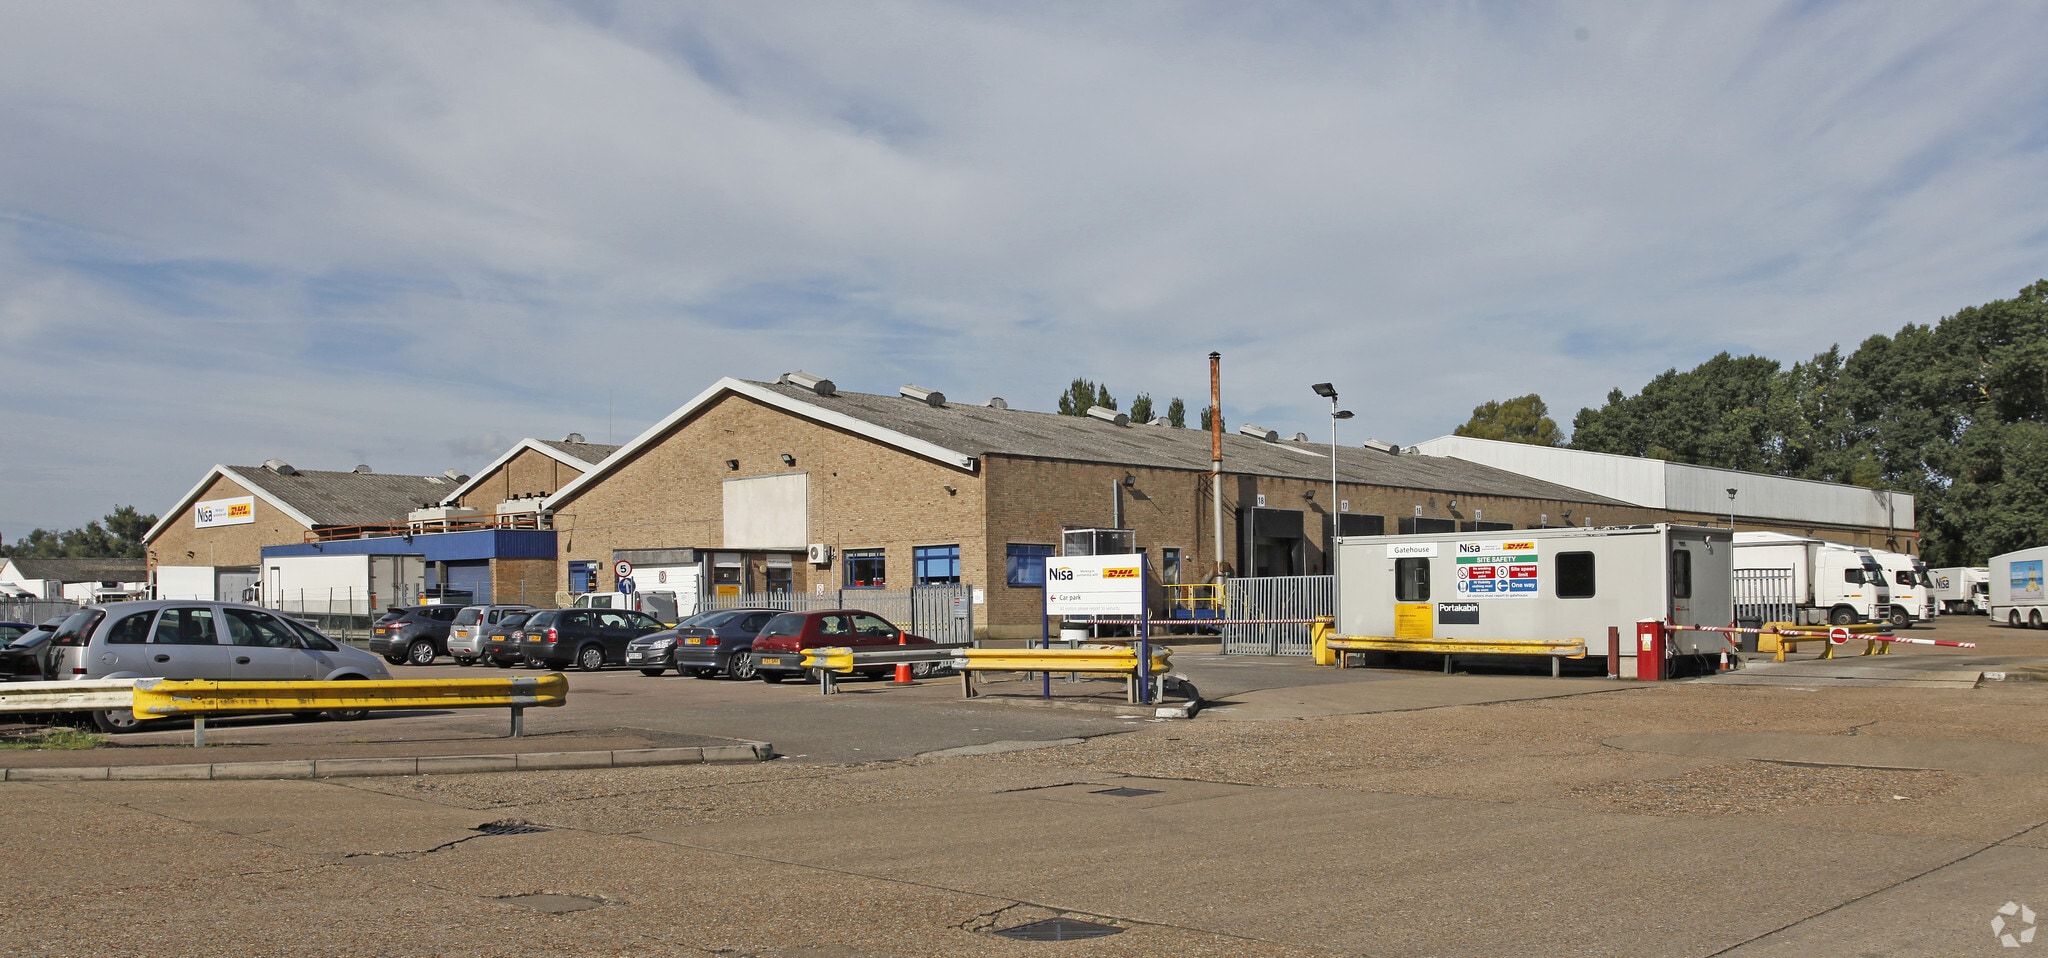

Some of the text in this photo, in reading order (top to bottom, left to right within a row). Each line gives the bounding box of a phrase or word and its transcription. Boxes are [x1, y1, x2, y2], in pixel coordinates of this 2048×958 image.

[1257, 496, 1265, 505] 18
[1342, 502, 1348, 510] 17
[197, 506, 213, 523] Nisa
[1394, 546, 1430, 554] Gatehouse
[1459, 542, 1481, 553] Nisa
[620, 565, 626, 573] 5
[1049, 567, 1073, 581] Nisa
[1935, 577, 1950, 589] Nisa
